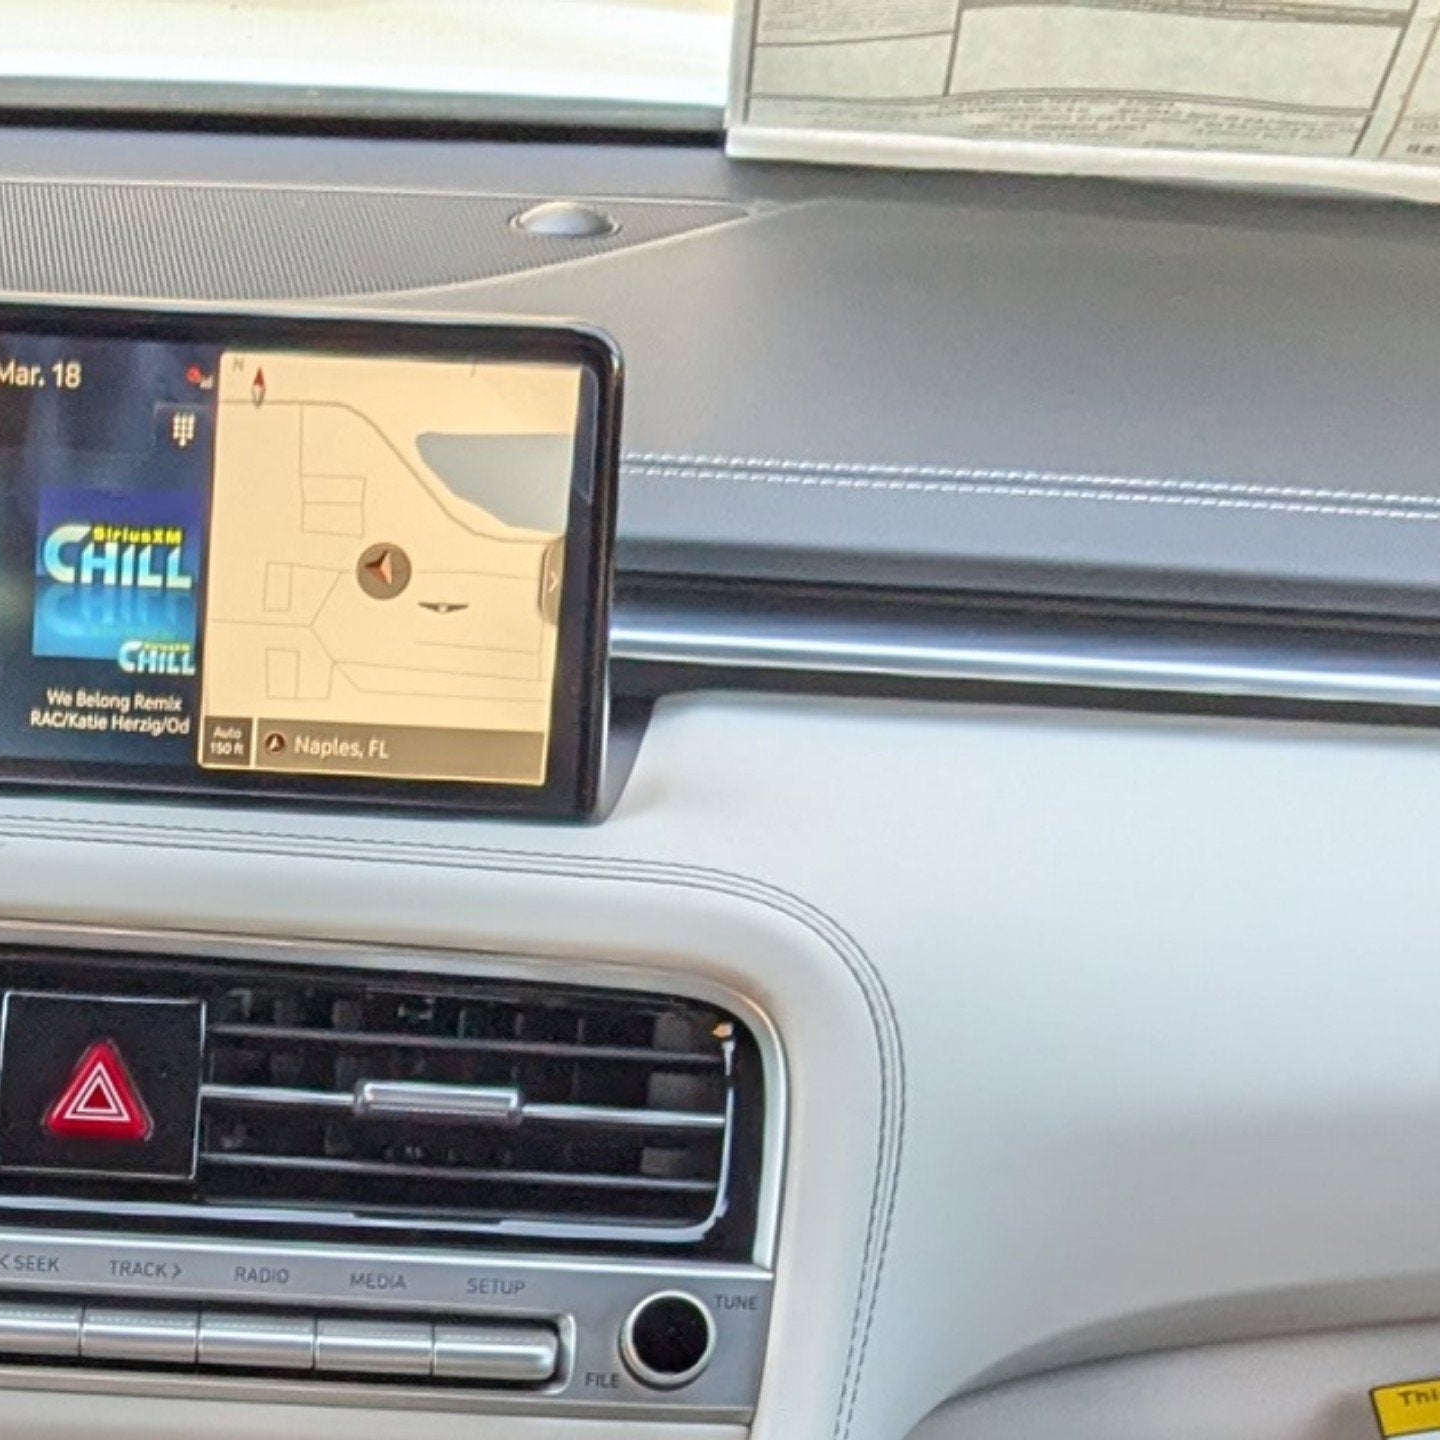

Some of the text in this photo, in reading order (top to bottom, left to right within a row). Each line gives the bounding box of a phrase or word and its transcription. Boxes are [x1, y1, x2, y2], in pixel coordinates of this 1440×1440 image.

[51, 360, 82, 388] 18
[44, 524, 193, 589] CHILL
[119, 640, 195, 676] CHILL
[47, 688, 183, 713] We Belong Remix
[30, 709, 190, 736] RAC/Katie Herzig/Od
[294, 735, 390, 760] Naples, FL
[13, 1256, 61, 1273] SEEK
[109, 1259, 169, 1280] TRACK
[234, 1265, 290, 1285] RADIO
[350, 1272, 407, 1292] MEDIA
[466, 1277, 526, 1297] SETUP
[715, 1295, 757, 1310] TUNE
[585, 1372, 619, 1389] FILE
